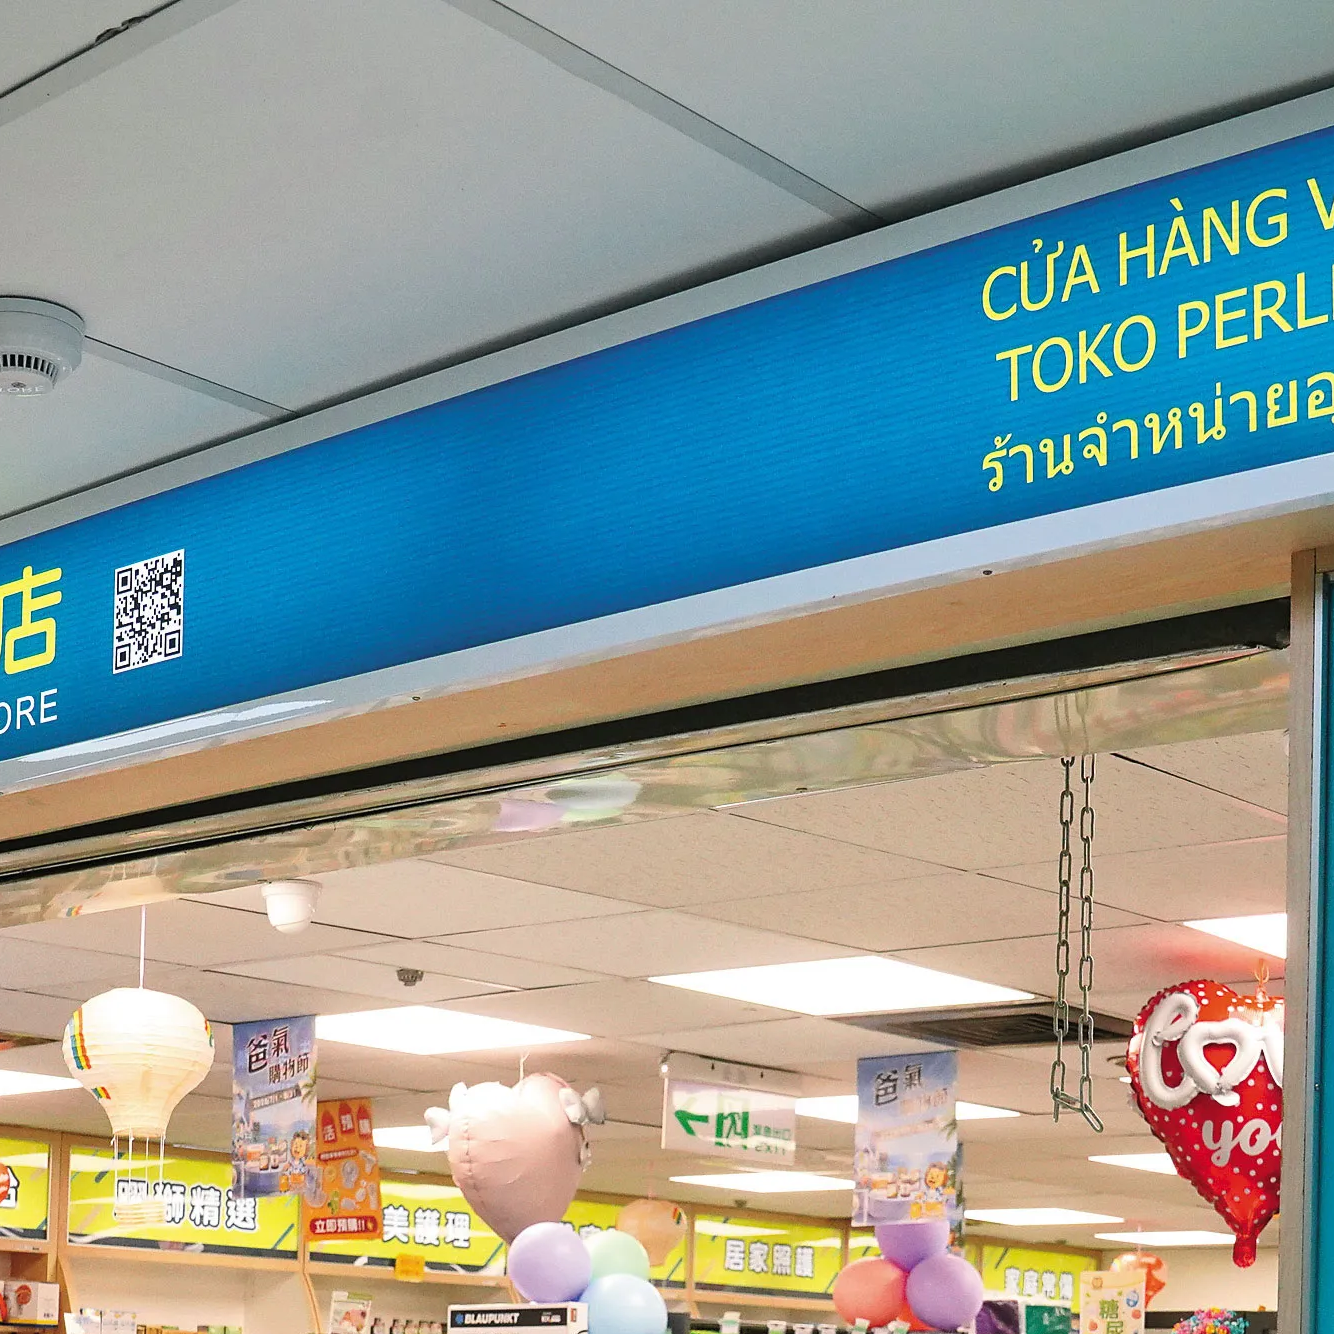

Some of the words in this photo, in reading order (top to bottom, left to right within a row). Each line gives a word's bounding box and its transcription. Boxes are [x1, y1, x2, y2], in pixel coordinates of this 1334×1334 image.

[979, 234, 1100, 322] CỬA
[1118, 188, 1289, 286] HÀNG
[995, 312, 1155, 402] TOKO
[1202, 1117, 1282, 1167] yo
[464, 1313, 520, 1325] BLAUPUNKT
